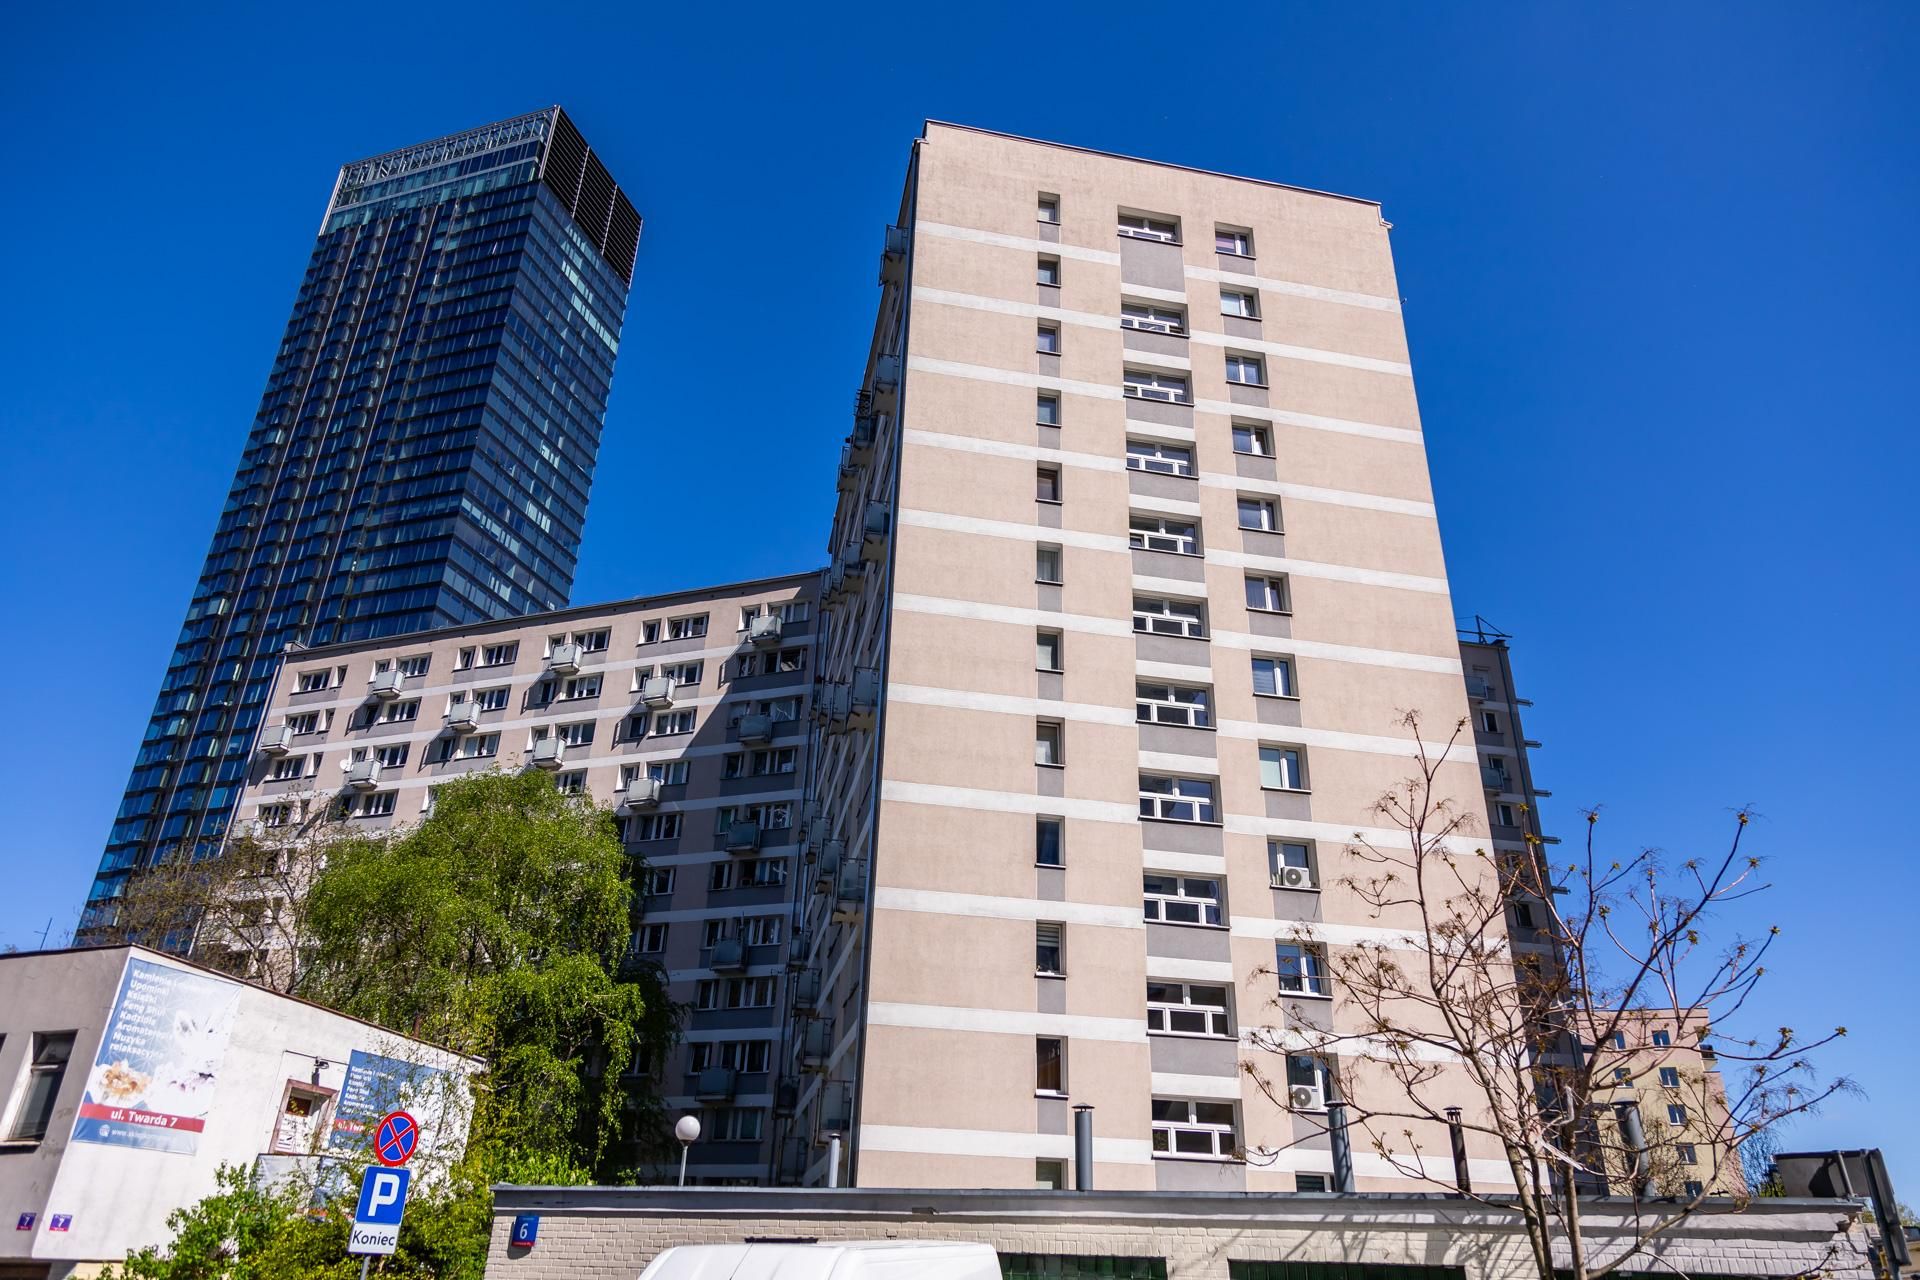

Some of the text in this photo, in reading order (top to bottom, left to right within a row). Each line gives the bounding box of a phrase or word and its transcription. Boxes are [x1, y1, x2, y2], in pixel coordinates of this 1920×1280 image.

[113, 1032, 146, 1047] Muzyka
[109, 1042, 164, 1060] relaksacyj
[111, 1109, 178, 1127] ul. Twarda 7
[368, 1173, 400, 1216] P
[352, 1230, 395, 1246] Koniec
[520, 1223, 528, 1239] 6
